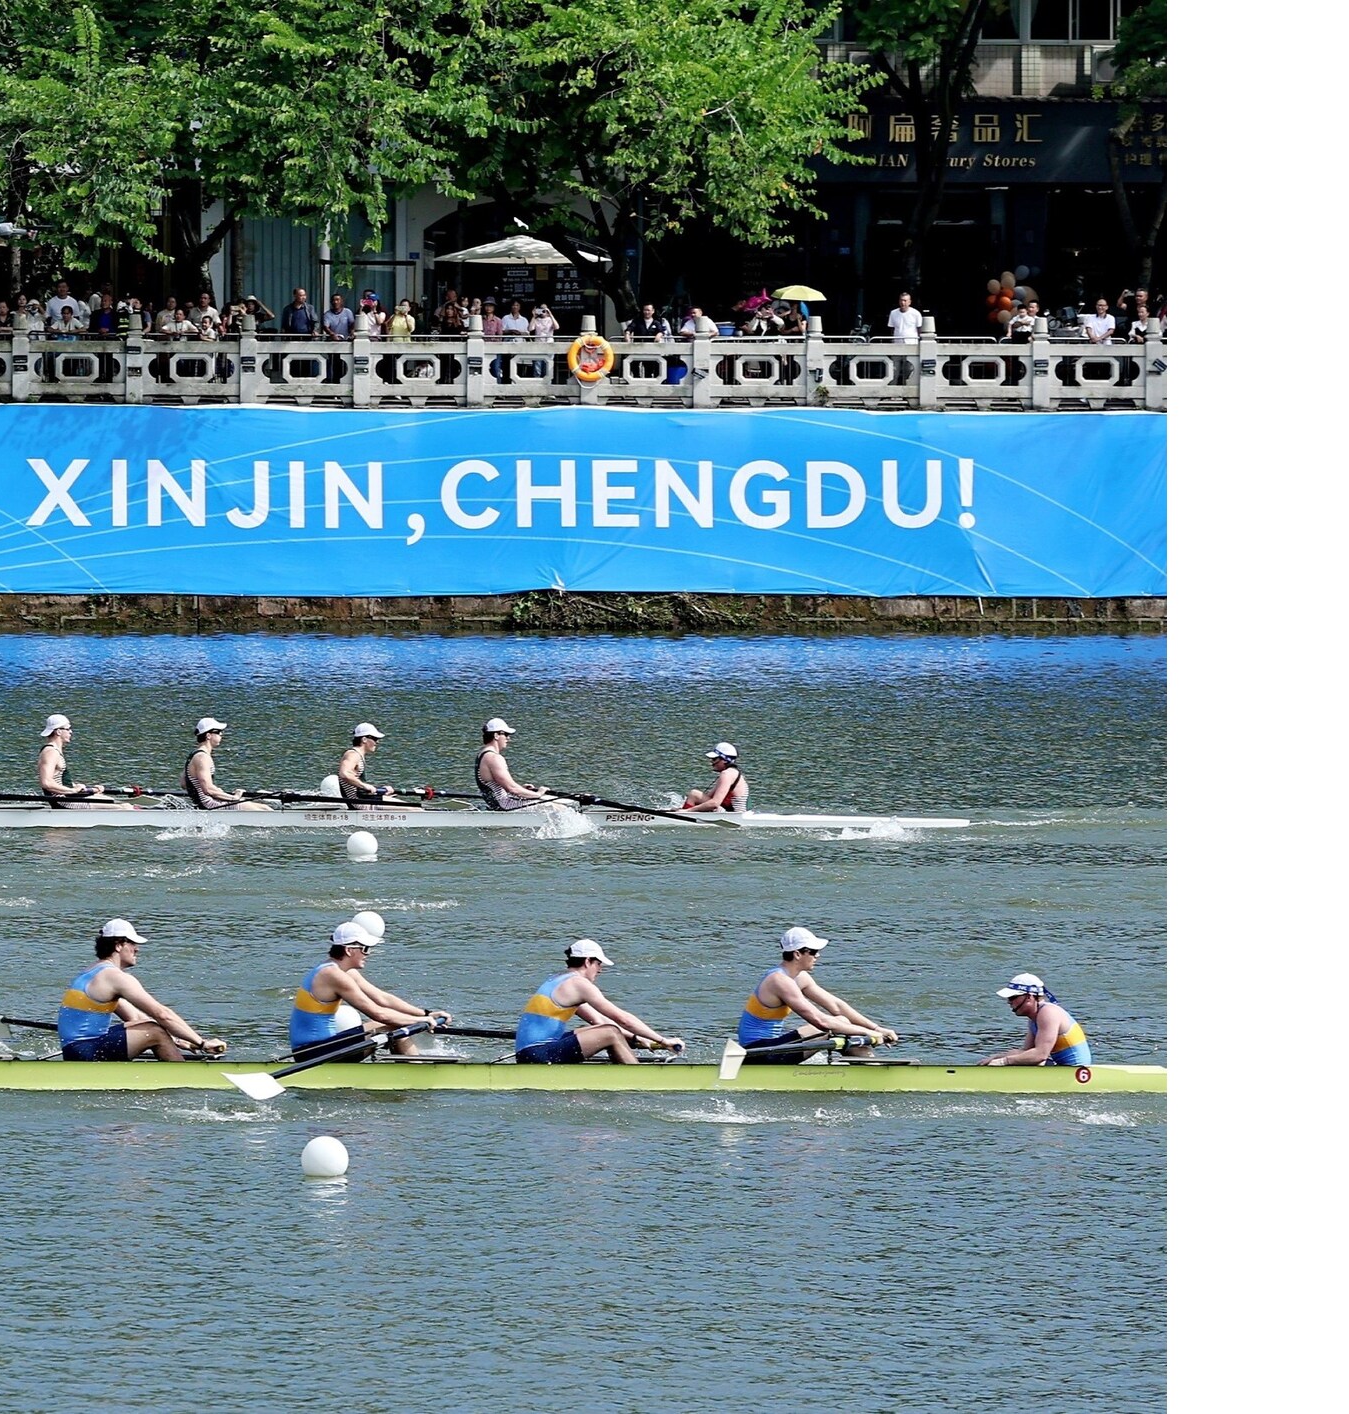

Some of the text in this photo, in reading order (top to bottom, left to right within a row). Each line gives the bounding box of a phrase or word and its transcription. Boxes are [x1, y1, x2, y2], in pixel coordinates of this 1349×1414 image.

[982, 153, 1037, 168] Stores
[605, 814, 651, 822] PEISHENG
[1079, 1069, 1089, 1082] 6
